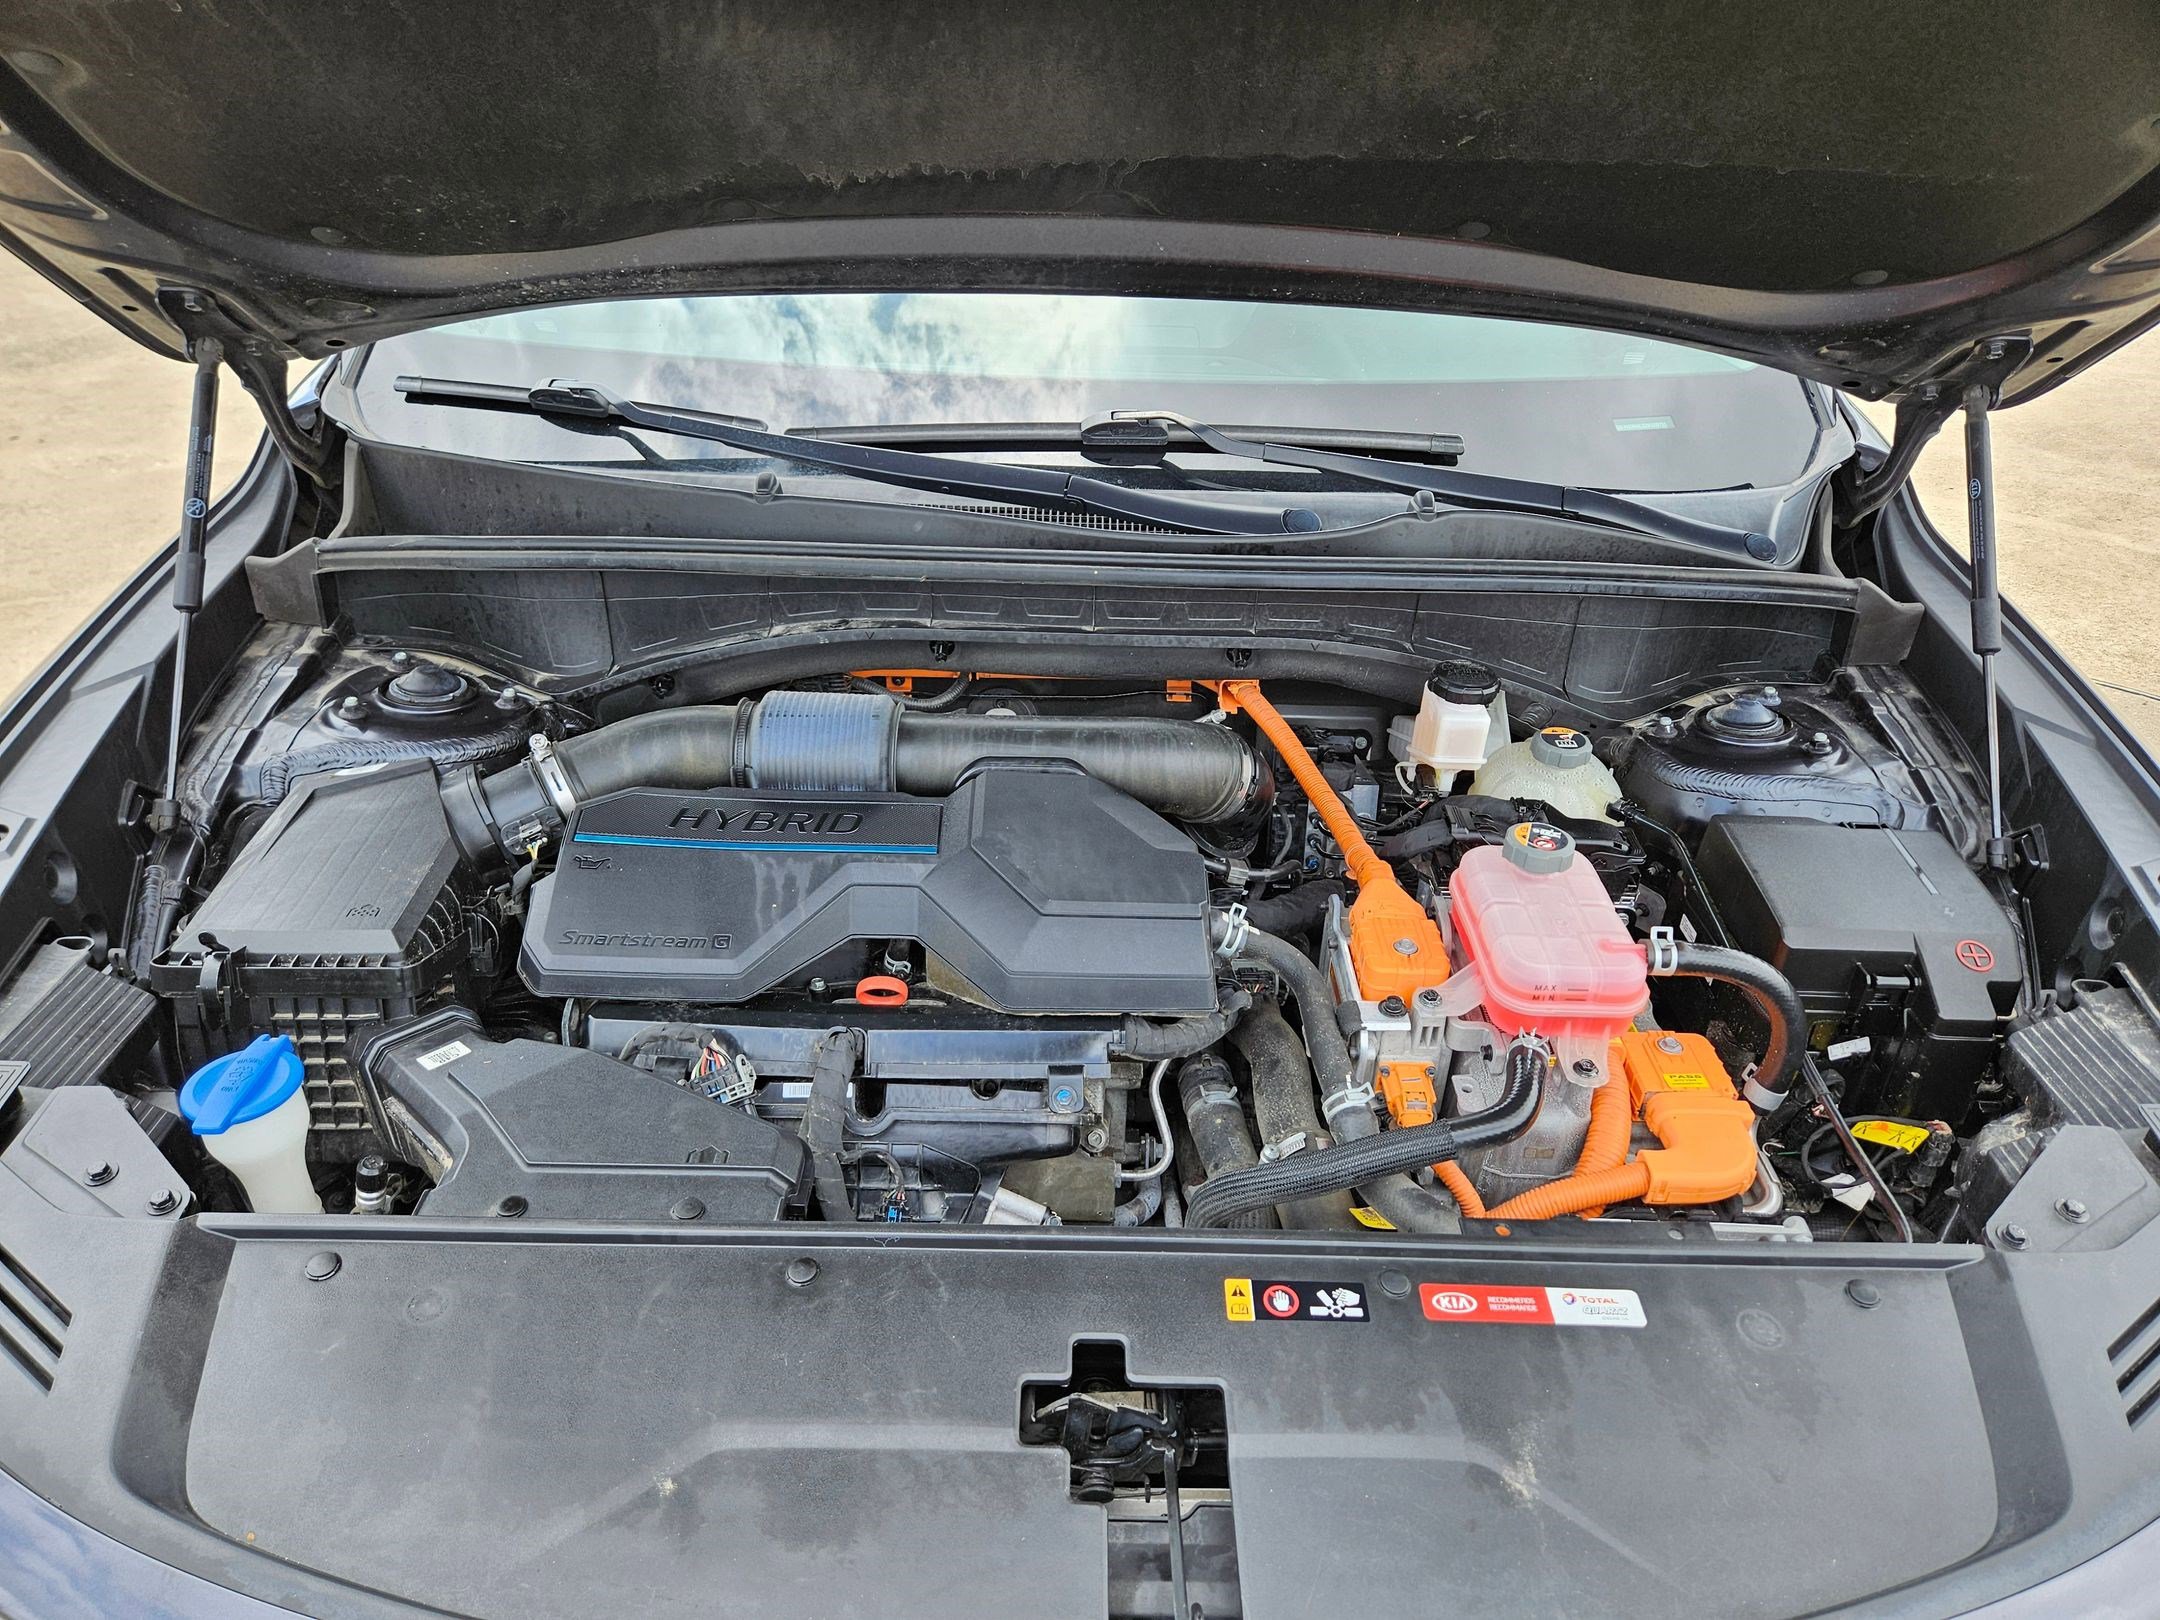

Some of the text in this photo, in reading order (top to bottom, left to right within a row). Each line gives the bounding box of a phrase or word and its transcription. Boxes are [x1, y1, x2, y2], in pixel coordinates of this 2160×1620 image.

[1970, 480, 1980, 498] KIA
[667, 807, 864, 835] HYBRID
[559, 930, 731, 950] Smartstream G
[1438, 1295, 1472, 1310] KIA
[1487, 1295, 1536, 1304] RECOMMENDS
[1579, 1296, 1620, 1304] TOTAL
[1583, 1305, 1629, 1316] QUARTZ
